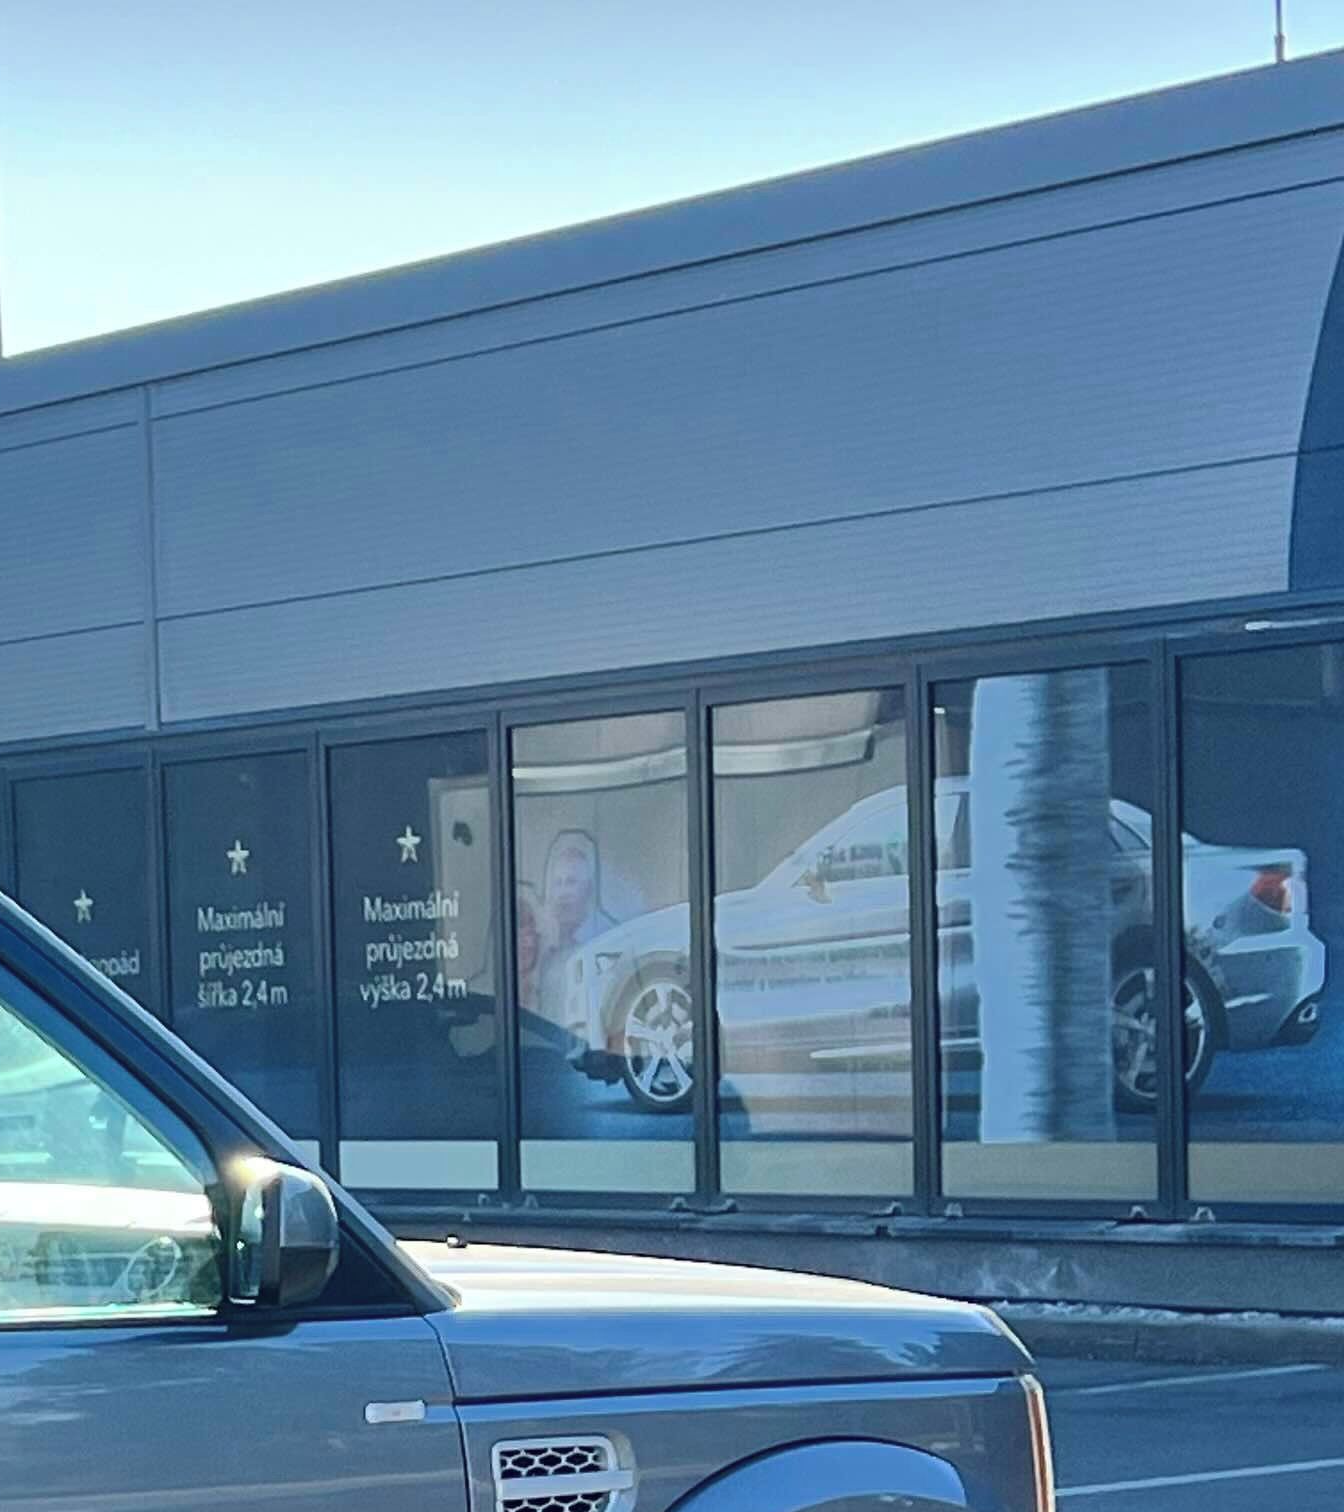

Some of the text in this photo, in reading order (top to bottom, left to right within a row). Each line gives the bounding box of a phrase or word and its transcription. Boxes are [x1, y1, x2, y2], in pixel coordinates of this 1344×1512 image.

[197, 901, 286, 932] Maximální
[363, 890, 460, 922] Maximální
[199, 940, 285, 977] průjezdná
[365, 931, 460, 969] průjezdná
[197, 979, 289, 1008] šířka 2,4 m
[359, 971, 467, 1008] výška 2,4 m
